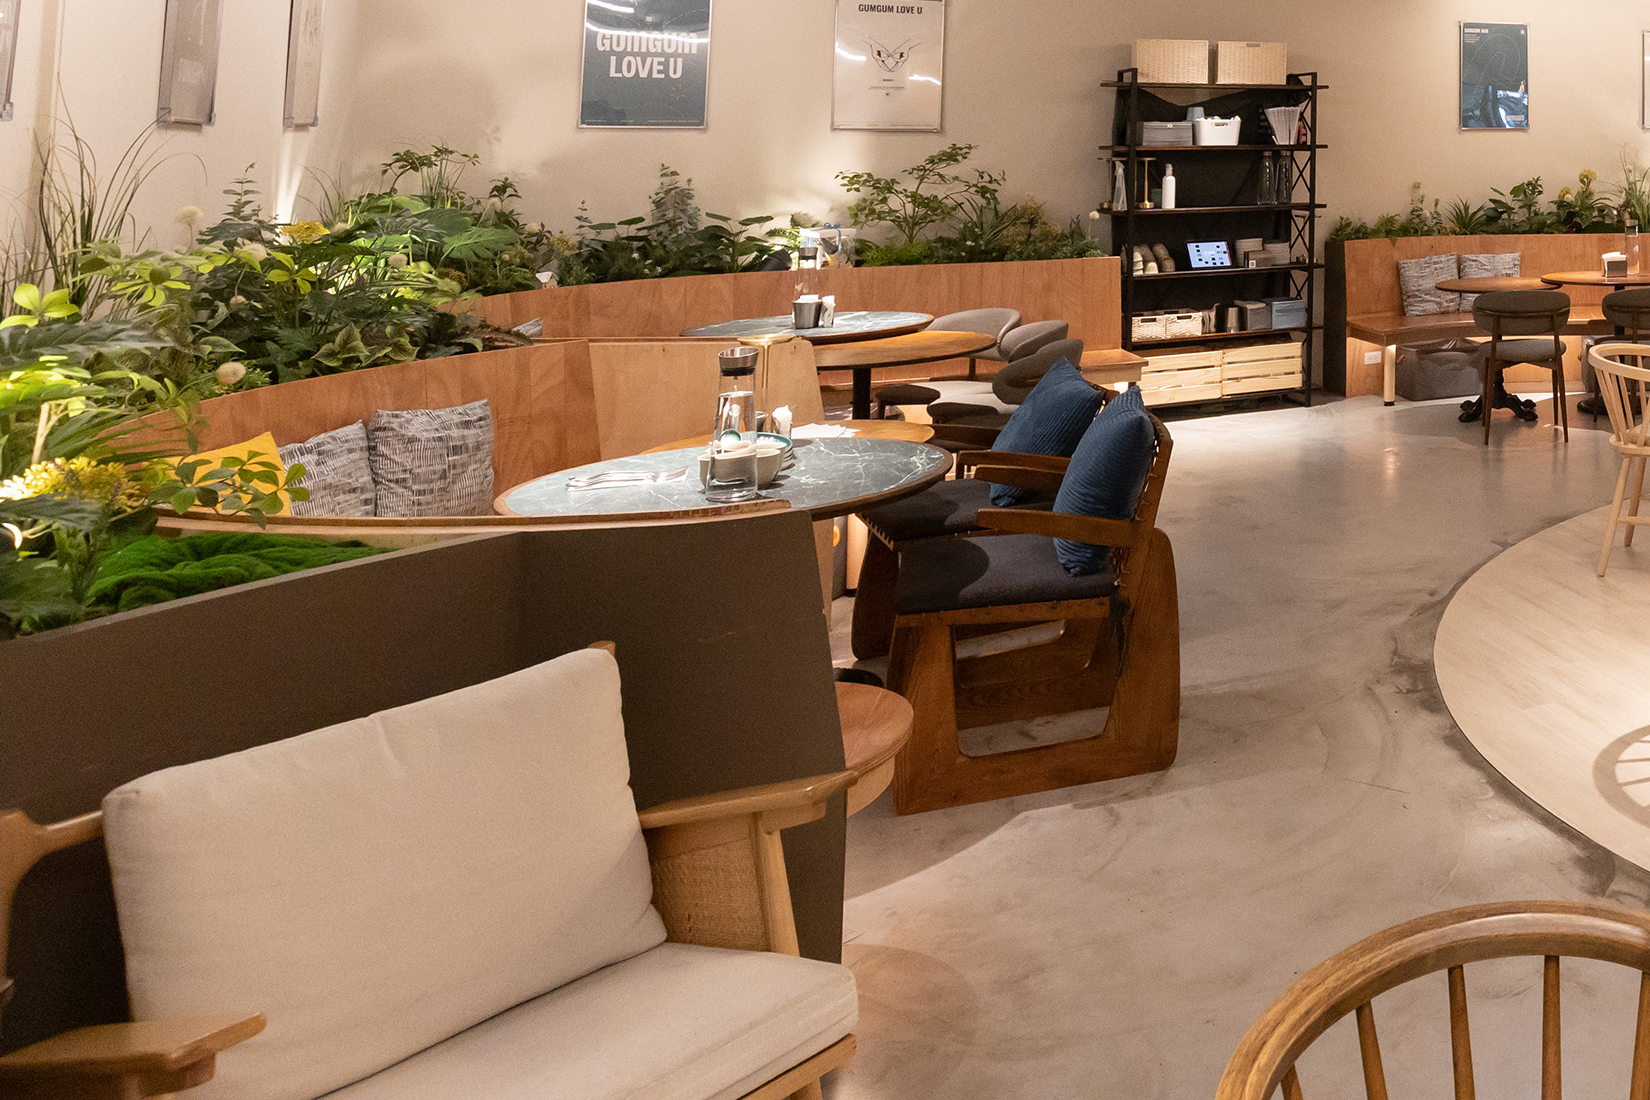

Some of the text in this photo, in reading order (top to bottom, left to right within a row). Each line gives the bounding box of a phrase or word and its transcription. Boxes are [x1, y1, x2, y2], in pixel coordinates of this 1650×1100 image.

[858, 3, 923, 15] GUMGUM LOVE U
[596, 31, 698, 54] GUMGUM
[609, 56, 684, 79] LOVE U
